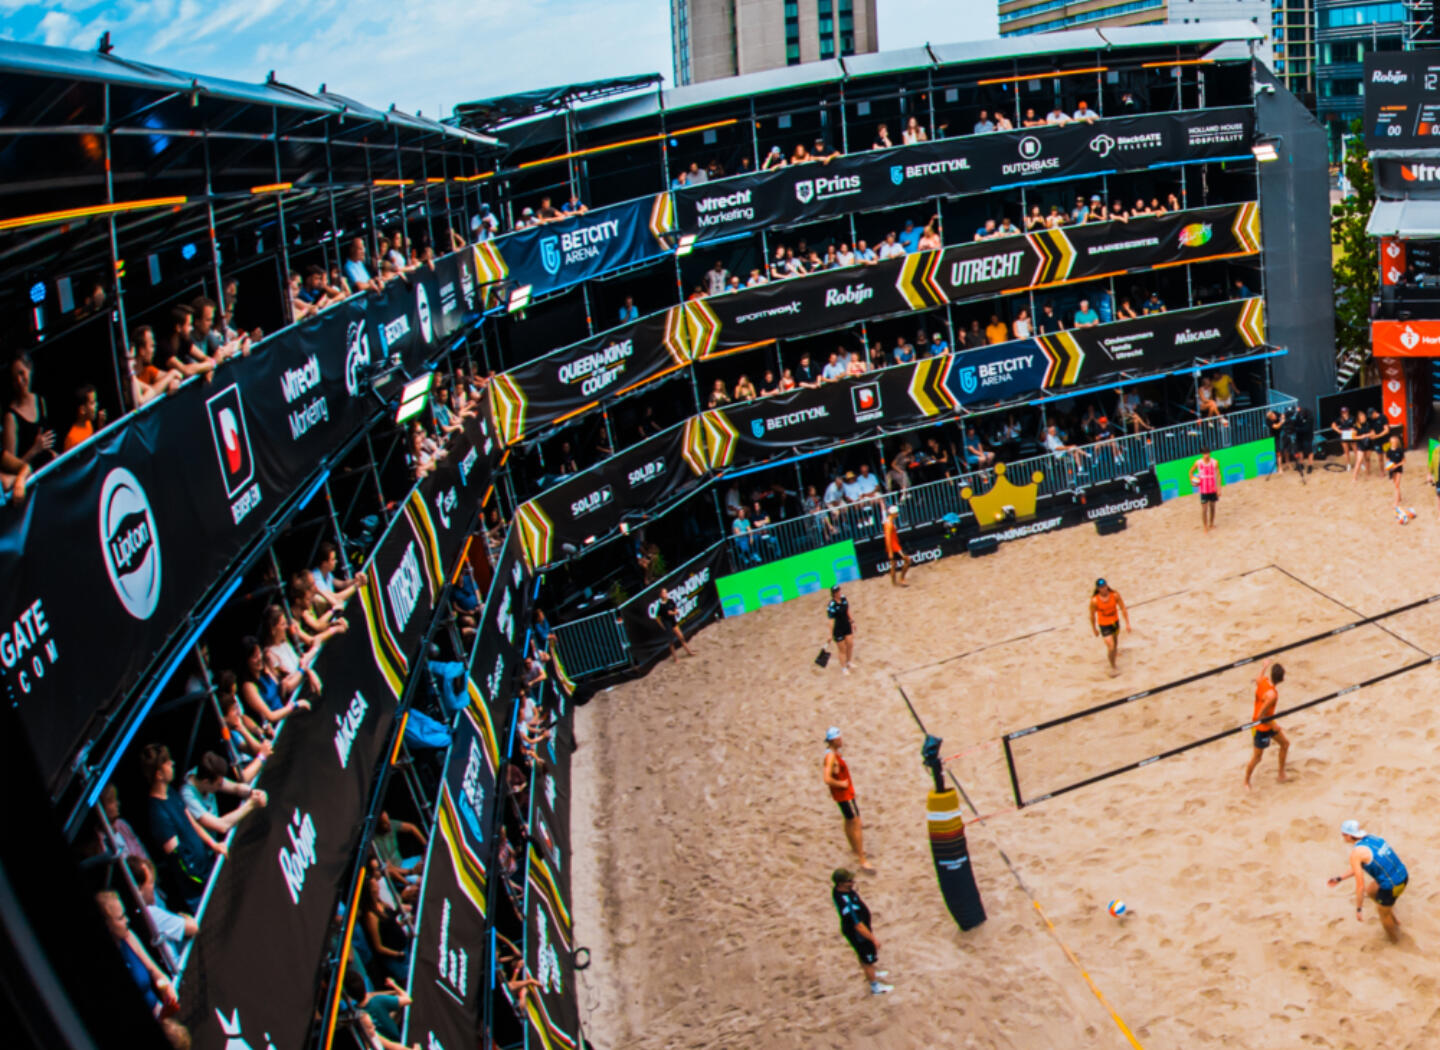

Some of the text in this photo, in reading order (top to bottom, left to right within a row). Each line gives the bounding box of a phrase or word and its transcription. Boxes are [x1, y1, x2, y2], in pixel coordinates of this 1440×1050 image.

[1372, 69, 1408, 85] Robijn
[1188, 134, 1243, 145] HOSPITALITY
[1387, 125, 1402, 136] 00
[1002, 158, 1060, 175] DUTCHBASE
[815, 174, 861, 194] Prins
[695, 189, 752, 213] Utrecht
[697, 206, 754, 228] Marketing
[561, 219, 620, 252] BETCITY
[565, 246, 600, 266] ARENA
[951, 251, 1025, 287] UTRECHT
[825, 283, 873, 307] Robijn
[978, 354, 1033, 378] BETCITY
[981, 372, 1012, 387] ARENA
[628, 463, 655, 486] SOLID
[571, 492, 600, 517] SOLID
[1087, 497, 1148, 520] waterdrop
[112, 521, 150, 568] Lipton
[279, 807, 317, 904] Robijn
